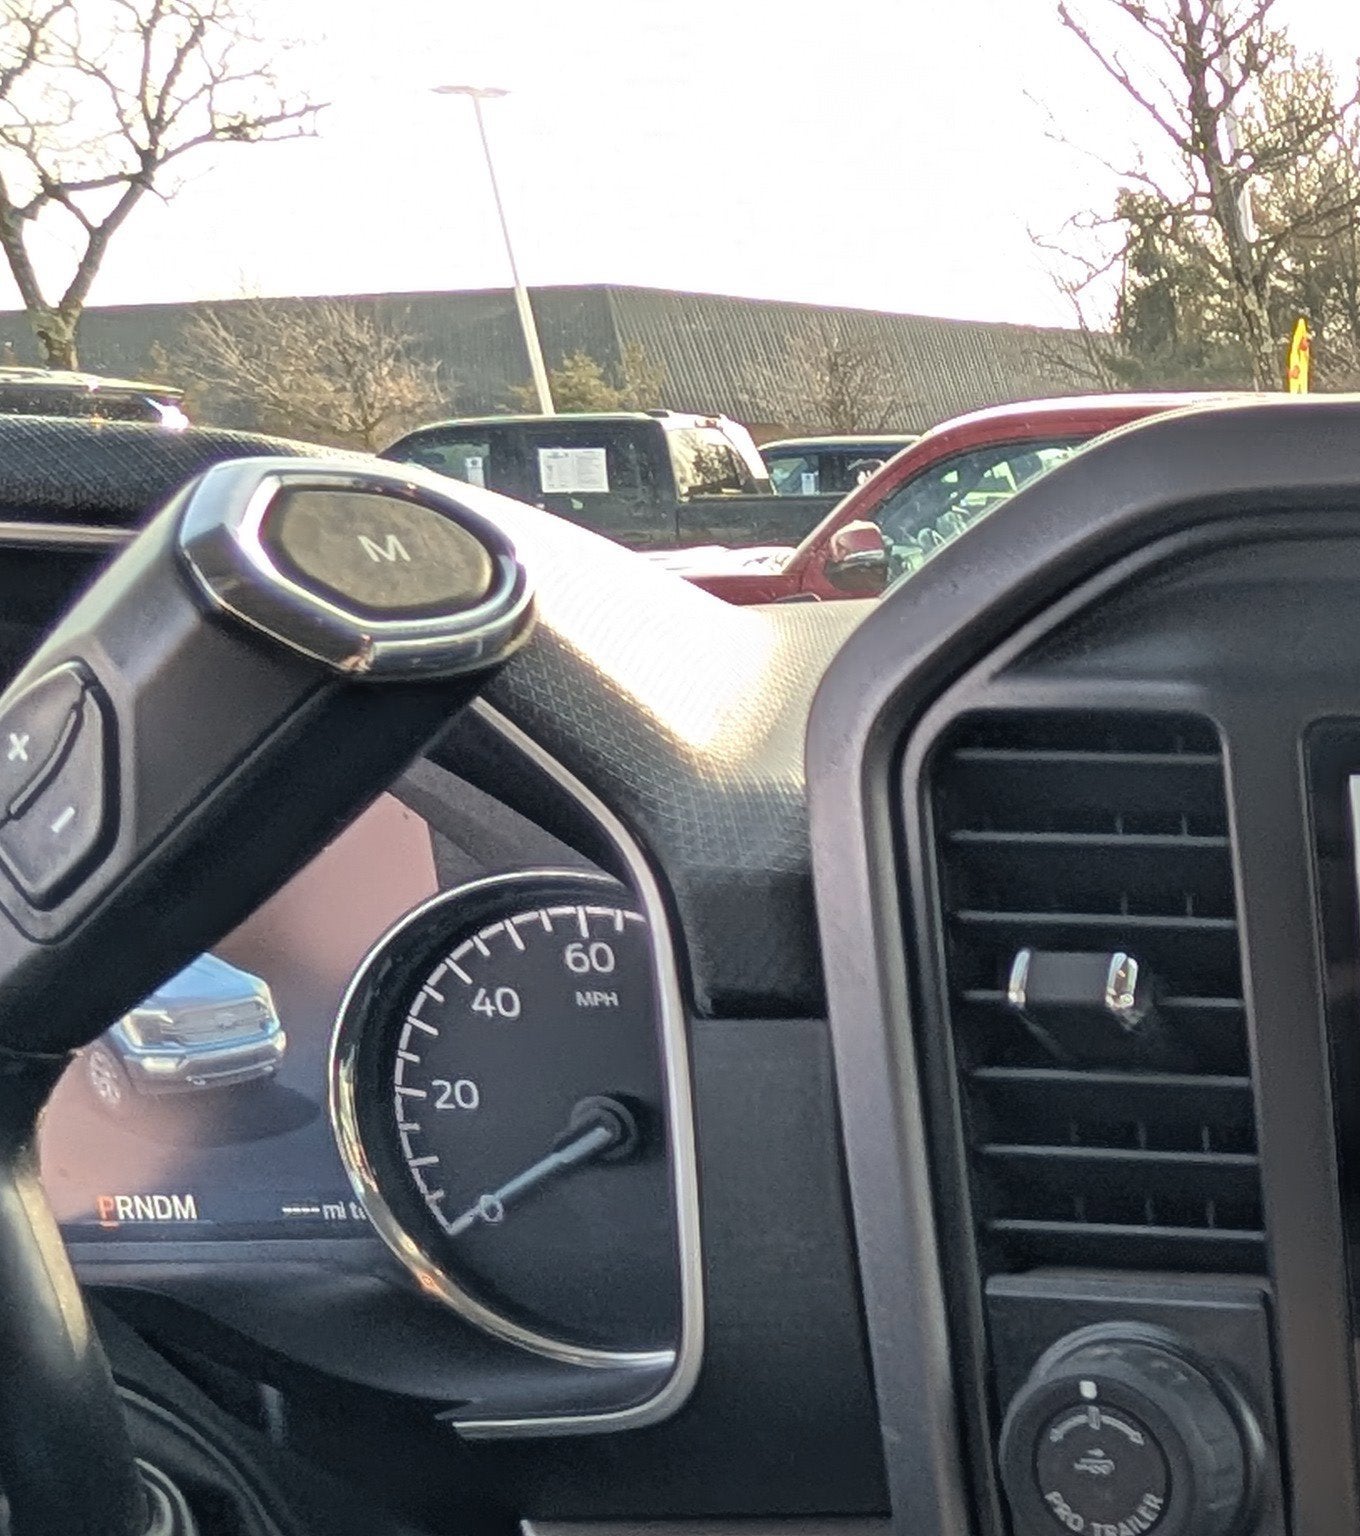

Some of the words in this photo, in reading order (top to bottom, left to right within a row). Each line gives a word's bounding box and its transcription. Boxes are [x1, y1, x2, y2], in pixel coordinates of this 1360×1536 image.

[565, 943, 614, 974] 60
[472, 987, 521, 1019] 40
[575, 992, 619, 1007] MPH
[432, 1080, 480, 1109] 20
[478, 1195, 503, 1223] 0
